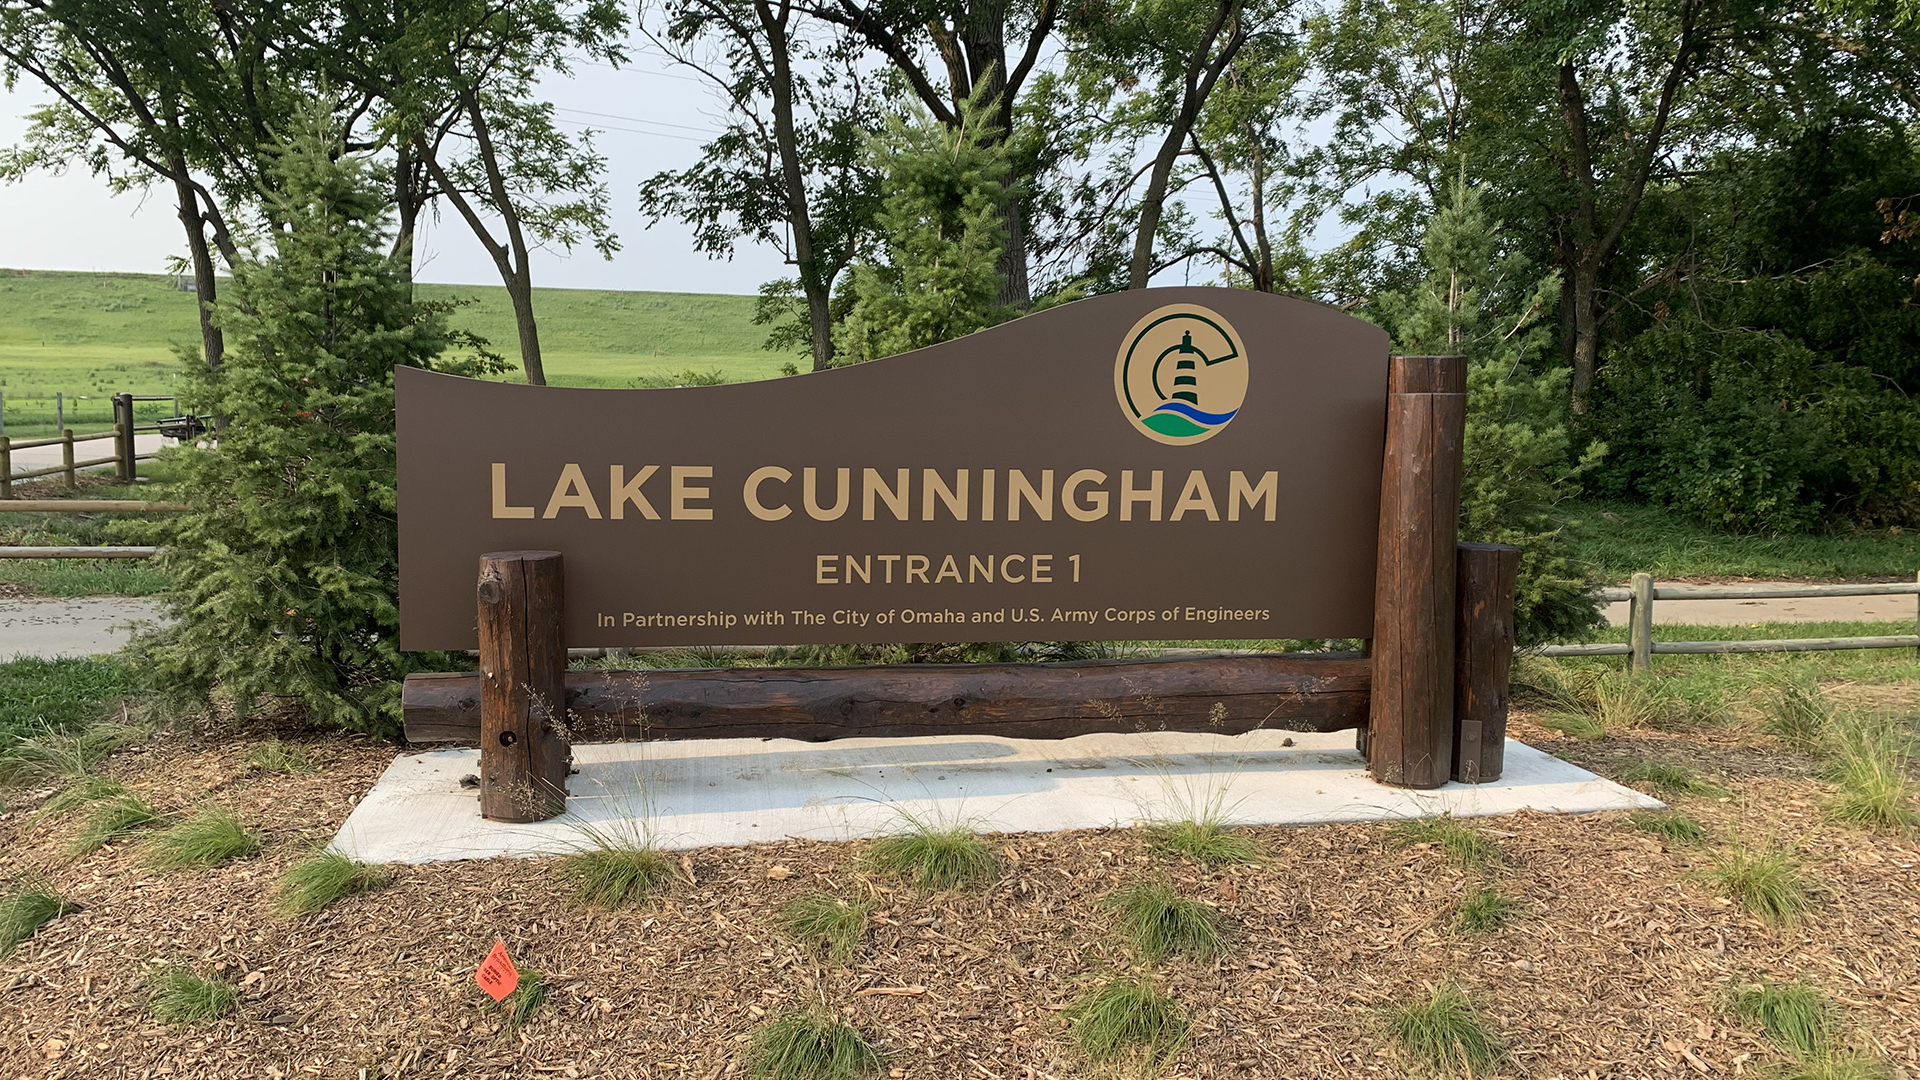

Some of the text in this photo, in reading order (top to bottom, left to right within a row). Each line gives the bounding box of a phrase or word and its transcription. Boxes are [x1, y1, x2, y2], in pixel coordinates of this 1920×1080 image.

[491, 463, 1279, 522] LAKE CUNNINGHAM
[816, 555, 1080, 584] ENTRANCE 1
[598, 607, 1270, 629] In Partnership with The City of Omaha and U.S. Army Corps of Engineers
